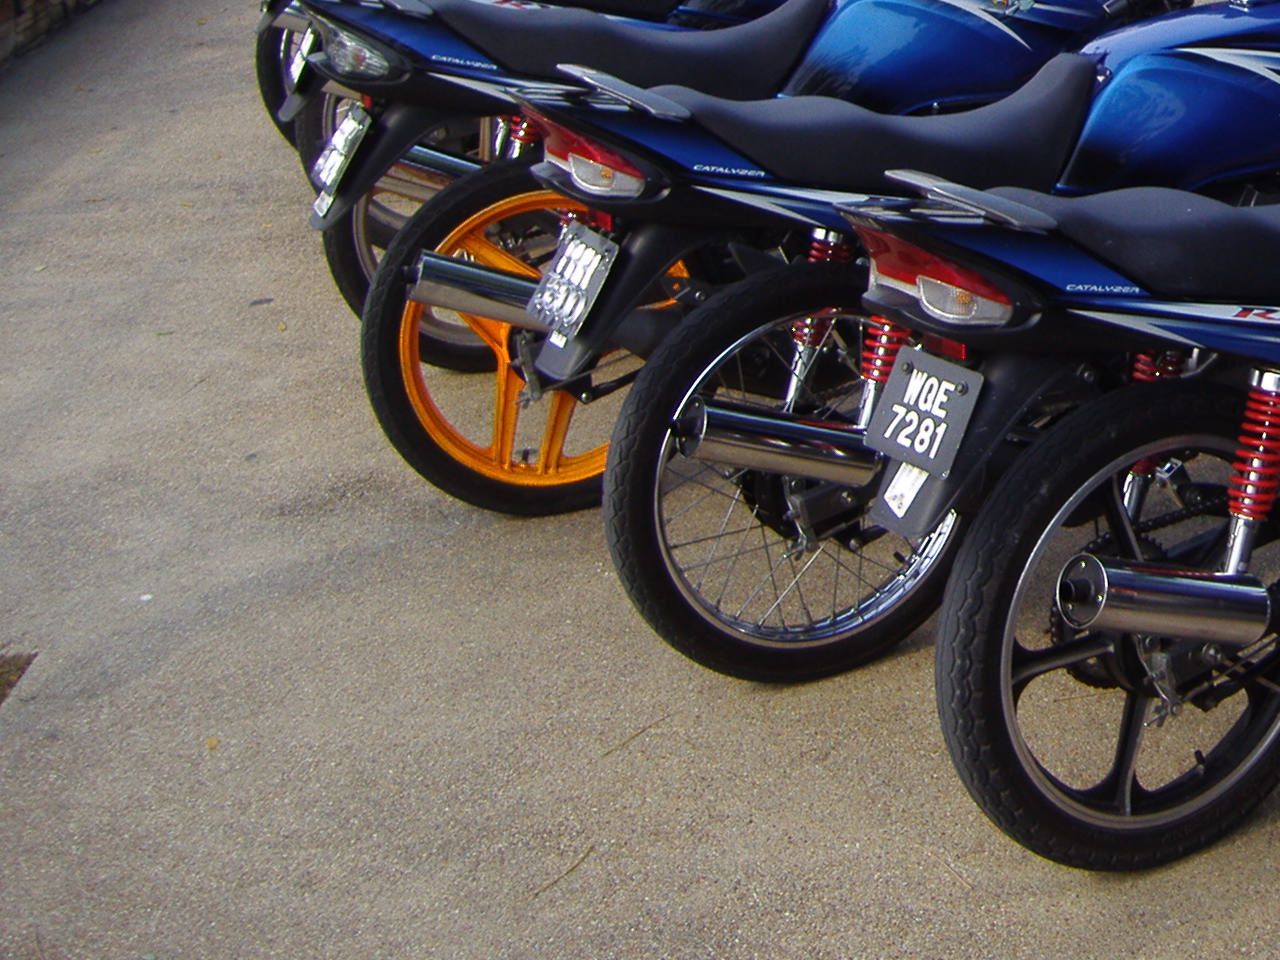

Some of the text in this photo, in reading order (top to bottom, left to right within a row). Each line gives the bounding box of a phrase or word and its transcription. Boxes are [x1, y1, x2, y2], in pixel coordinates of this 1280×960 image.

[693, 164, 766, 177] CATALYZER
[1066, 284, 1140, 294] CATALYZER
[904, 368, 956, 419] WQE
[884, 404, 948, 460] 7281
